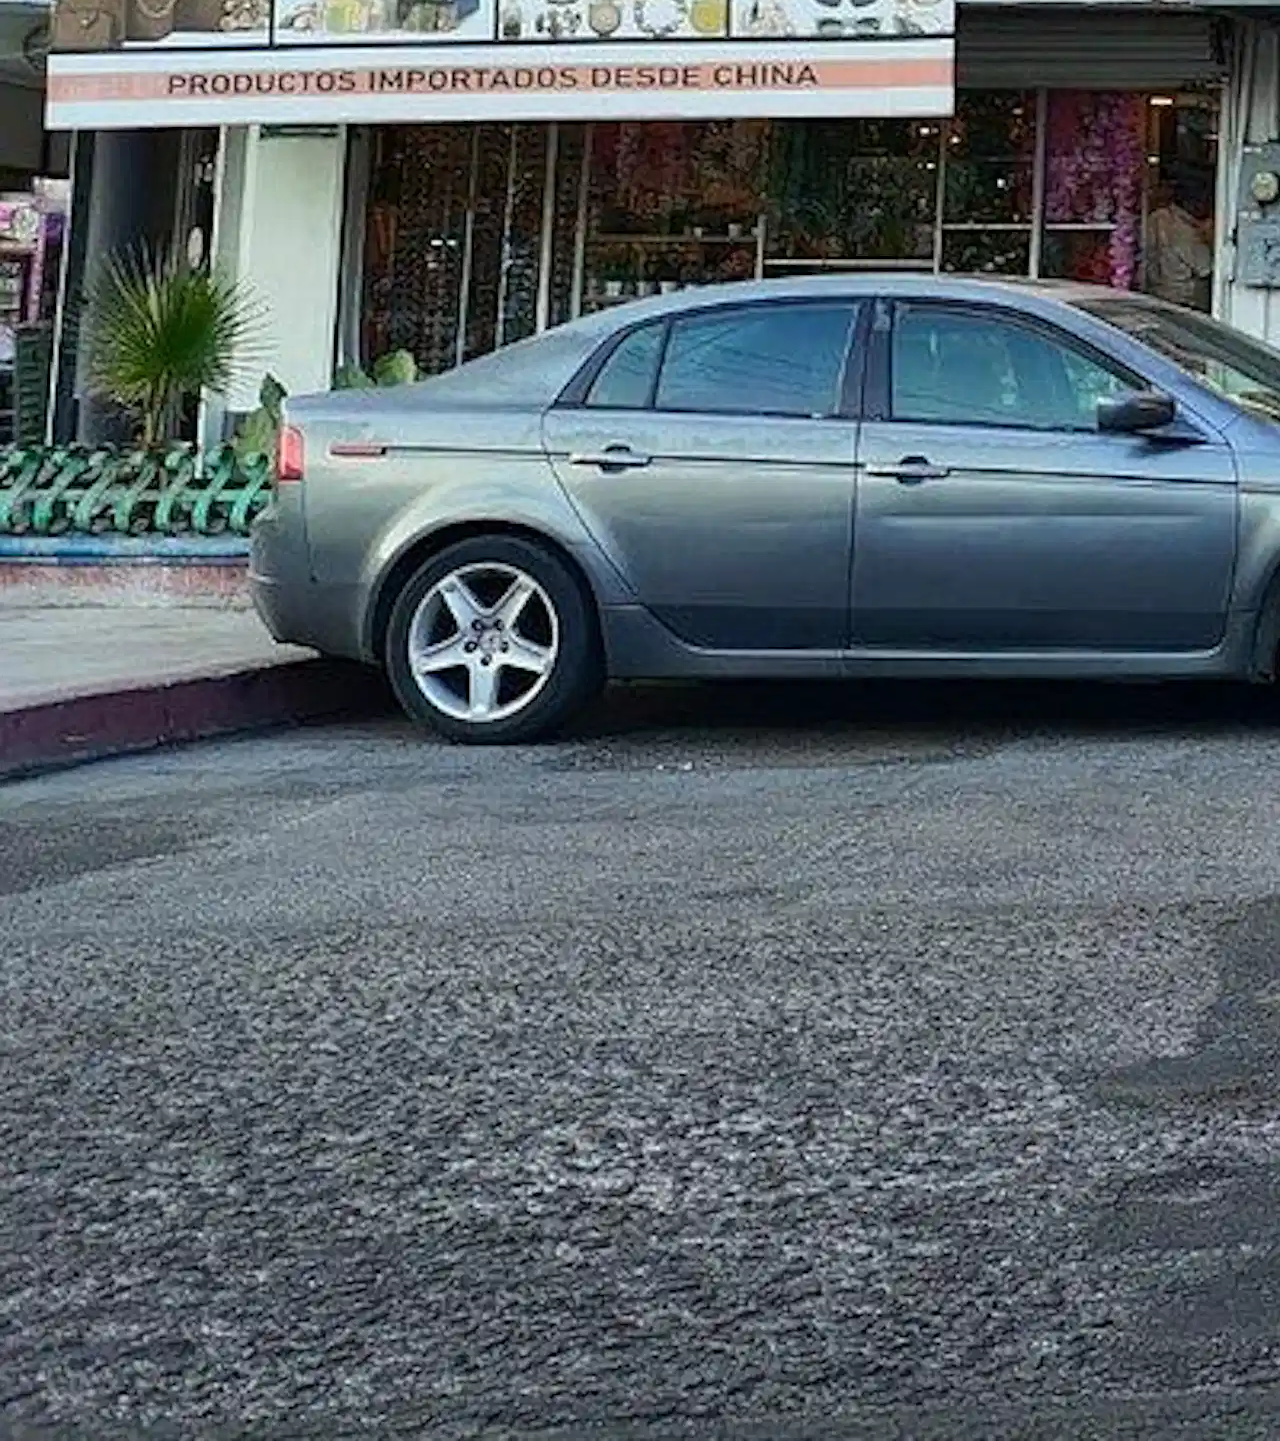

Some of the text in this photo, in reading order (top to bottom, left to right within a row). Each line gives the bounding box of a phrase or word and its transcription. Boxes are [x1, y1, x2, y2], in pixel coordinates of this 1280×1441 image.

[167, 63, 818, 95] PRODUCTOS IMPORTADOS DESDE CHINA
